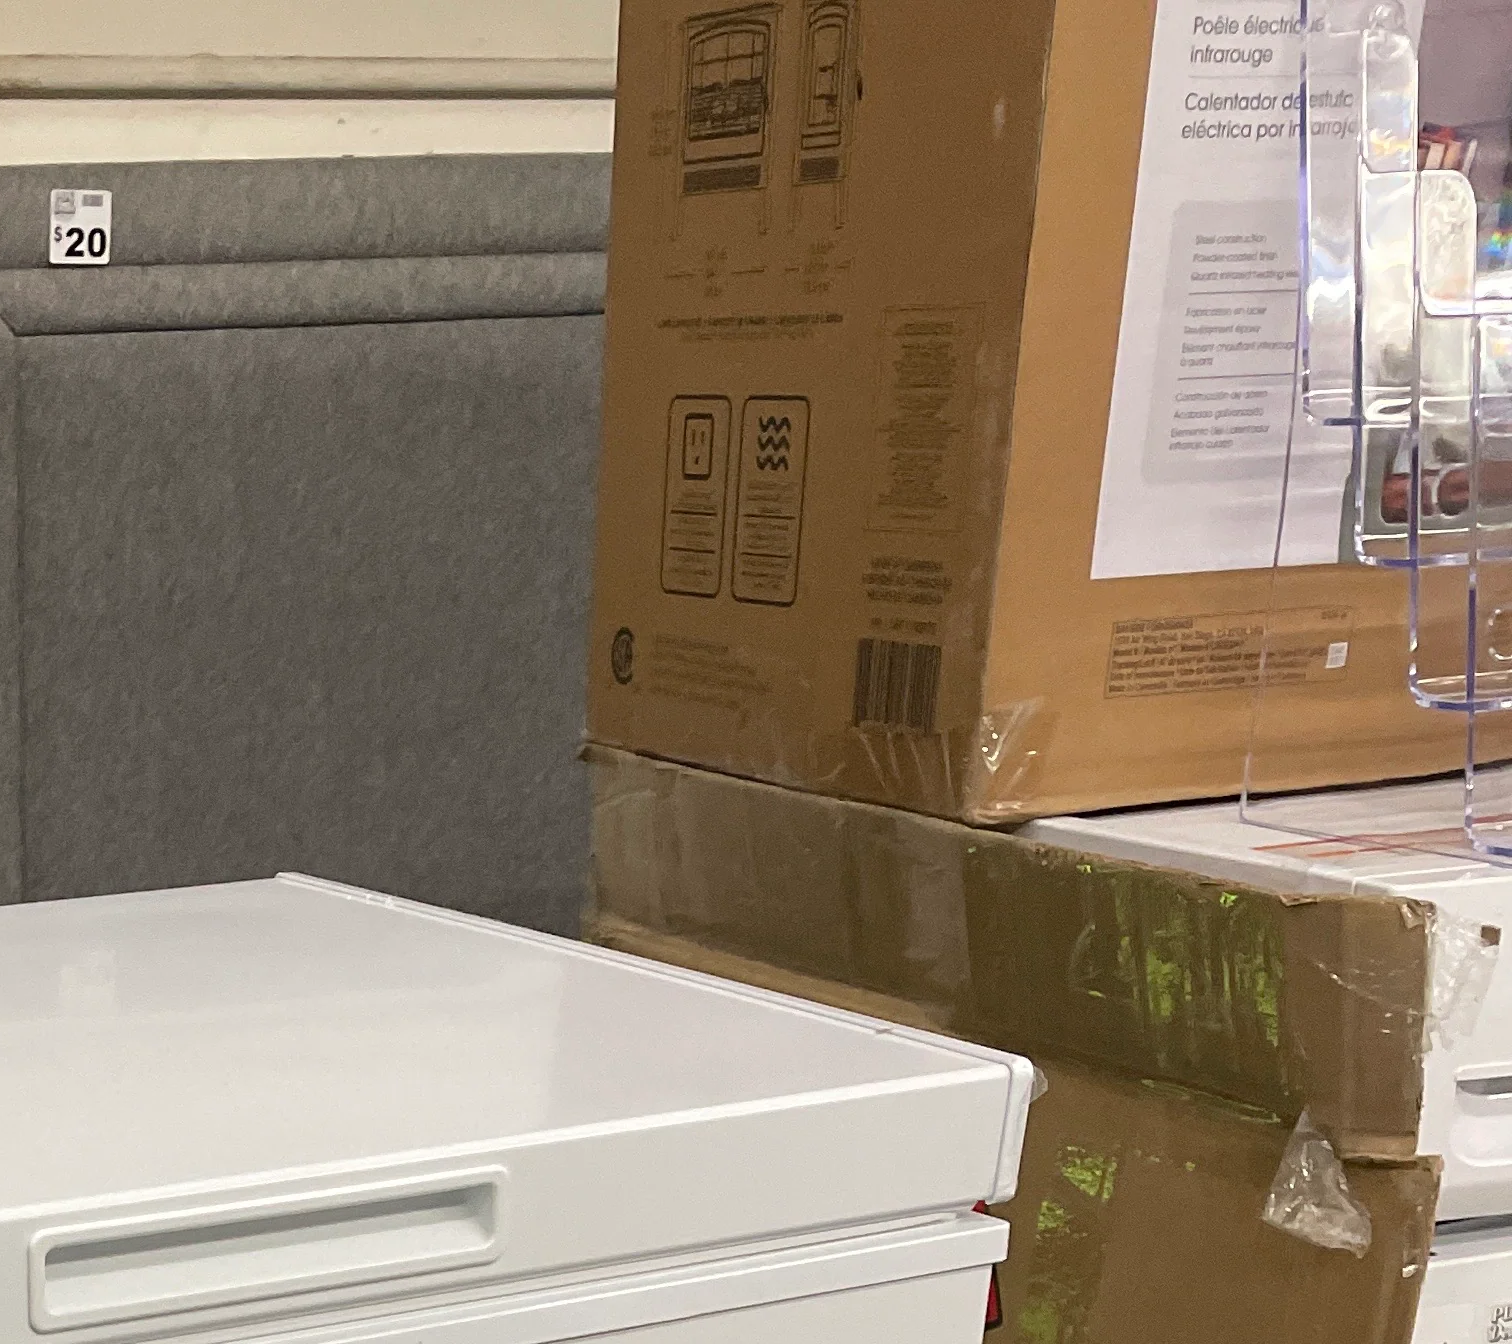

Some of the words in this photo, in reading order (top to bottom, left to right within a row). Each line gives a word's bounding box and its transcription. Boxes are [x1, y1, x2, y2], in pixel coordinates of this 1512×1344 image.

[1193, 15, 1239, 35] Poêle
[1190, 44, 1273, 68] infrarouge
[1184, 92, 1277, 111] Calentador
[1181, 119, 1252, 139] eléctrica
[1256, 123, 1286, 142] por
[1288, 119, 1358, 140] inarroj
[54, 226, 107, 258] $20
